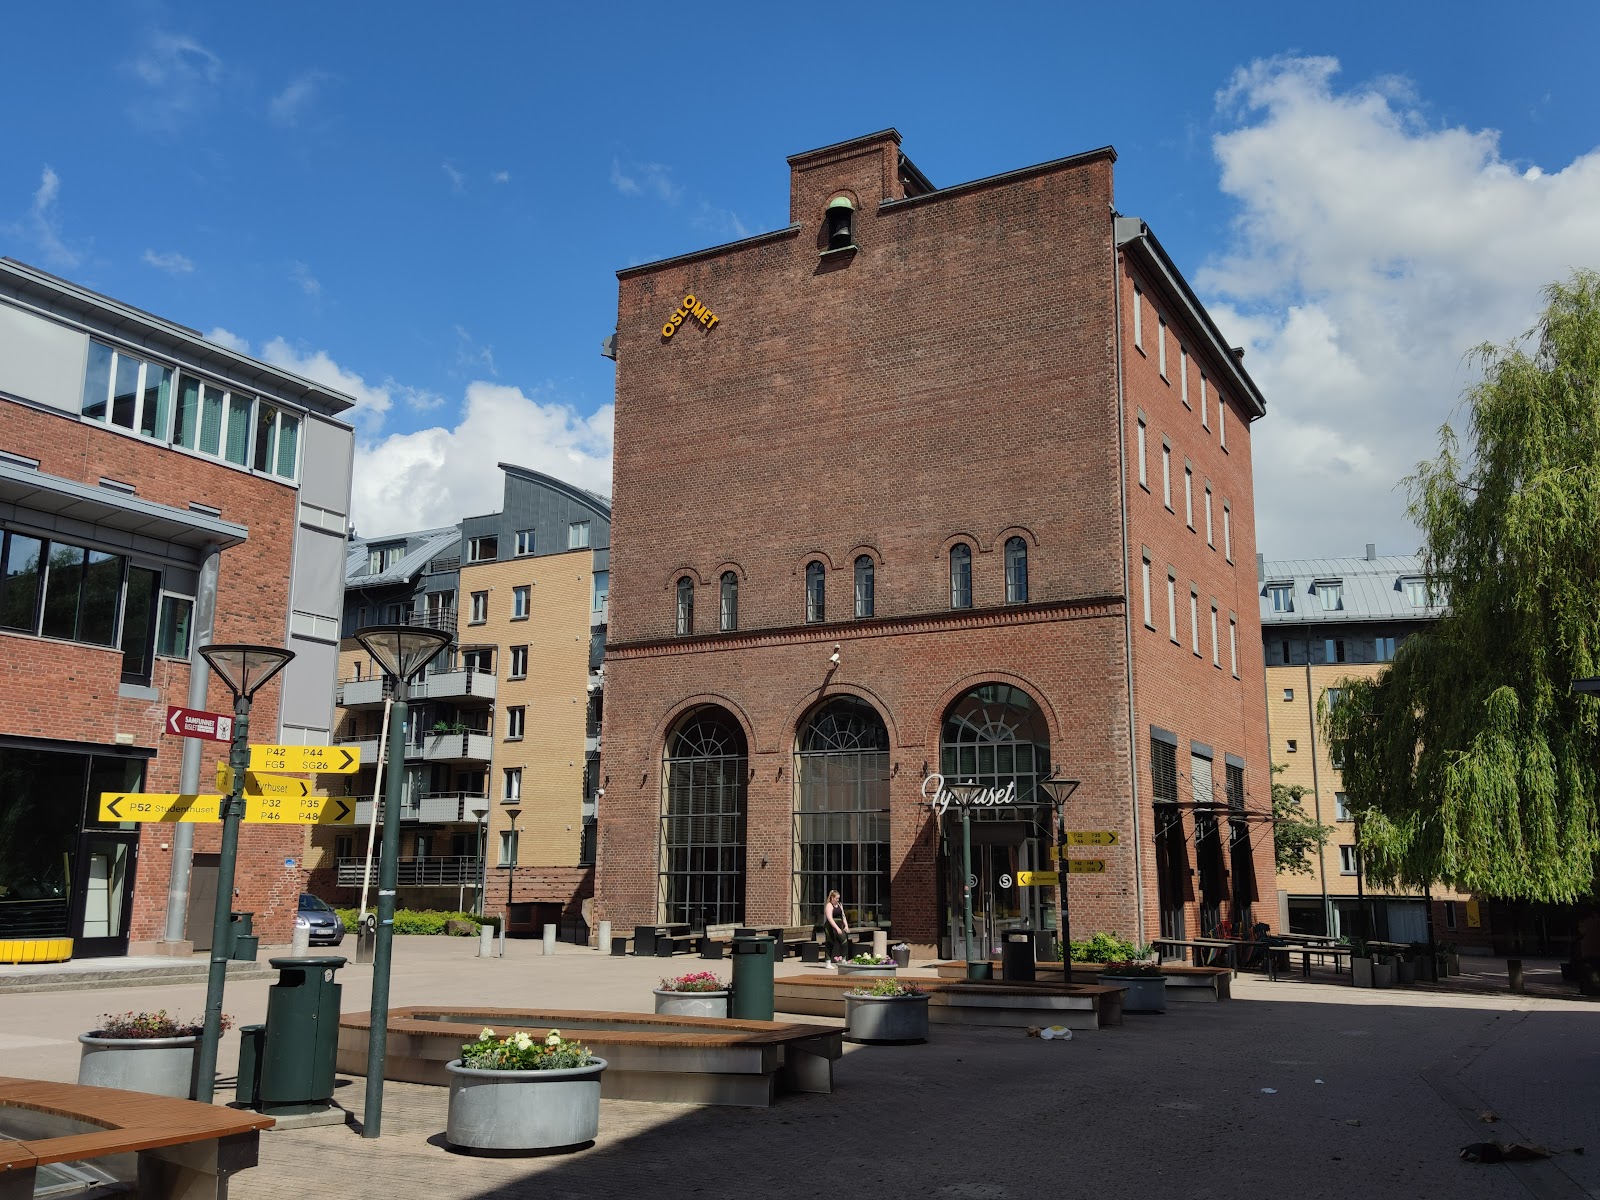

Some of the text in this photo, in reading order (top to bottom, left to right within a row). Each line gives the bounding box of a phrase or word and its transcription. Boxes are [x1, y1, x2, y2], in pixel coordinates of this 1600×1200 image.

[662, 294, 720, 337] OSLOMET
[266, 748, 323, 757] P42 P44
[265, 761, 329, 770] FG5 SG26
[130, 802, 214, 814] P52 Studenthuset
[262, 799, 320, 808] P32 P35
[261, 811, 319, 821] P46 P48
